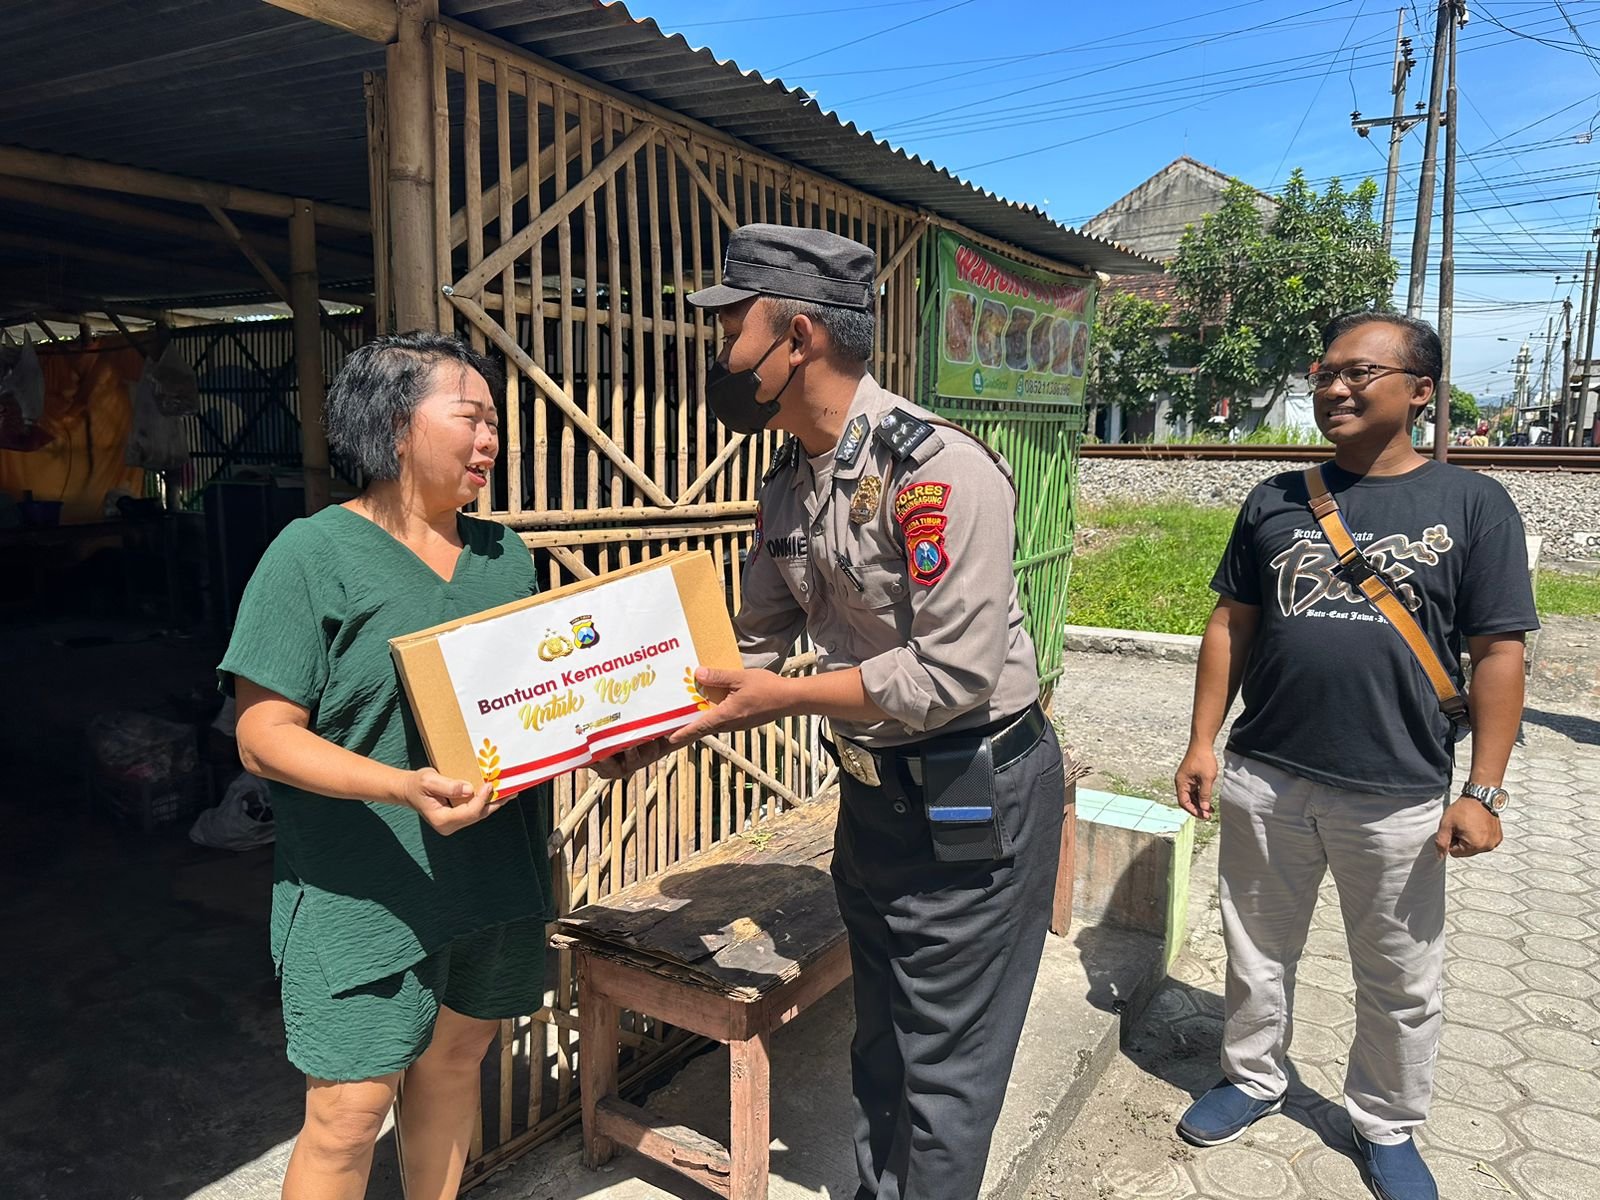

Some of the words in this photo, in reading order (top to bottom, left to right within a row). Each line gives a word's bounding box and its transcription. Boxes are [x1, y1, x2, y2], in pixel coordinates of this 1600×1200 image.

[896, 485, 943, 508] POLRES
[920, 517, 942, 525] TIMUR
[1292, 528, 1322, 540] Kota
[477, 680, 557, 715] Bantuan
[561, 637, 680, 687] Kemanusiaan
[518, 689, 585, 731] Untuk
[594, 664, 656, 705] Negeri
